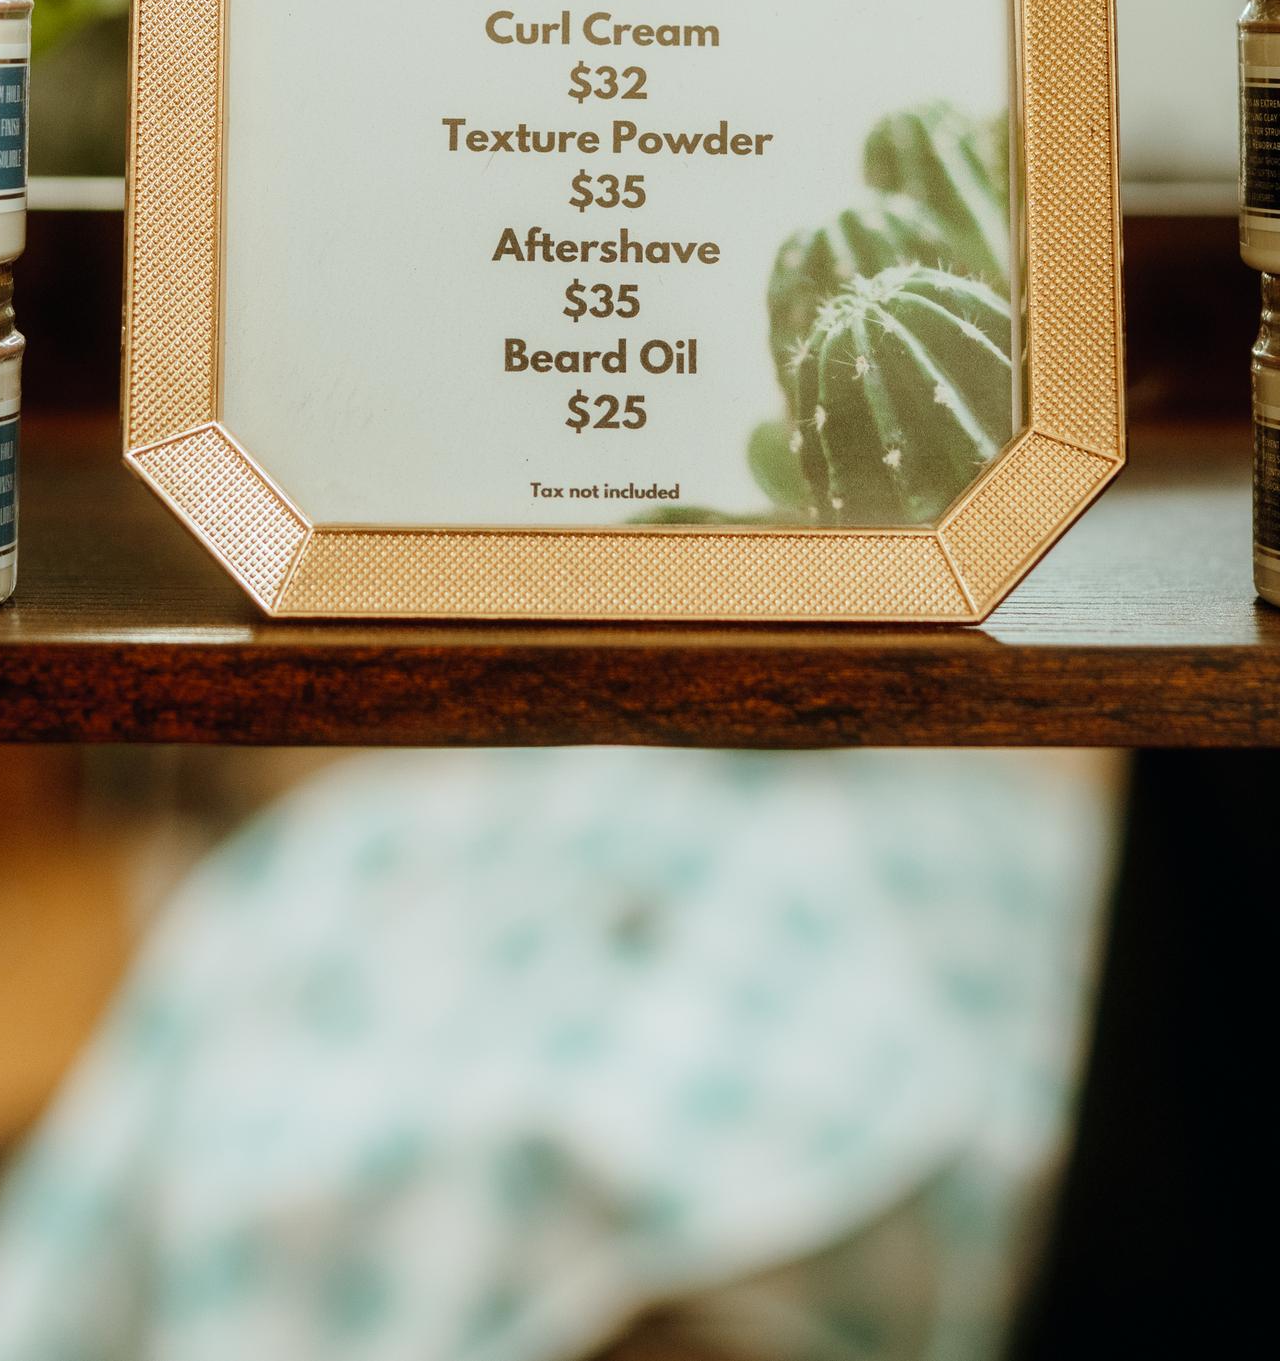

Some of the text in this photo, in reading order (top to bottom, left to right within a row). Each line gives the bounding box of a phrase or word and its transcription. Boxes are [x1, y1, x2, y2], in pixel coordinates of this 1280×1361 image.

[485, 10, 720, 47] Curl Cream
[568, 60, 648, 104] $32
[442, 118, 774, 156] Texture Powder
[569, 169, 646, 213] $35
[491, 226, 721, 265] Aftershave
[563, 278, 640, 323] $35
[504, 338, 698, 375] Beard Oil
[565, 389, 647, 434] $25
[530, 482, 680, 500] Tax not included
